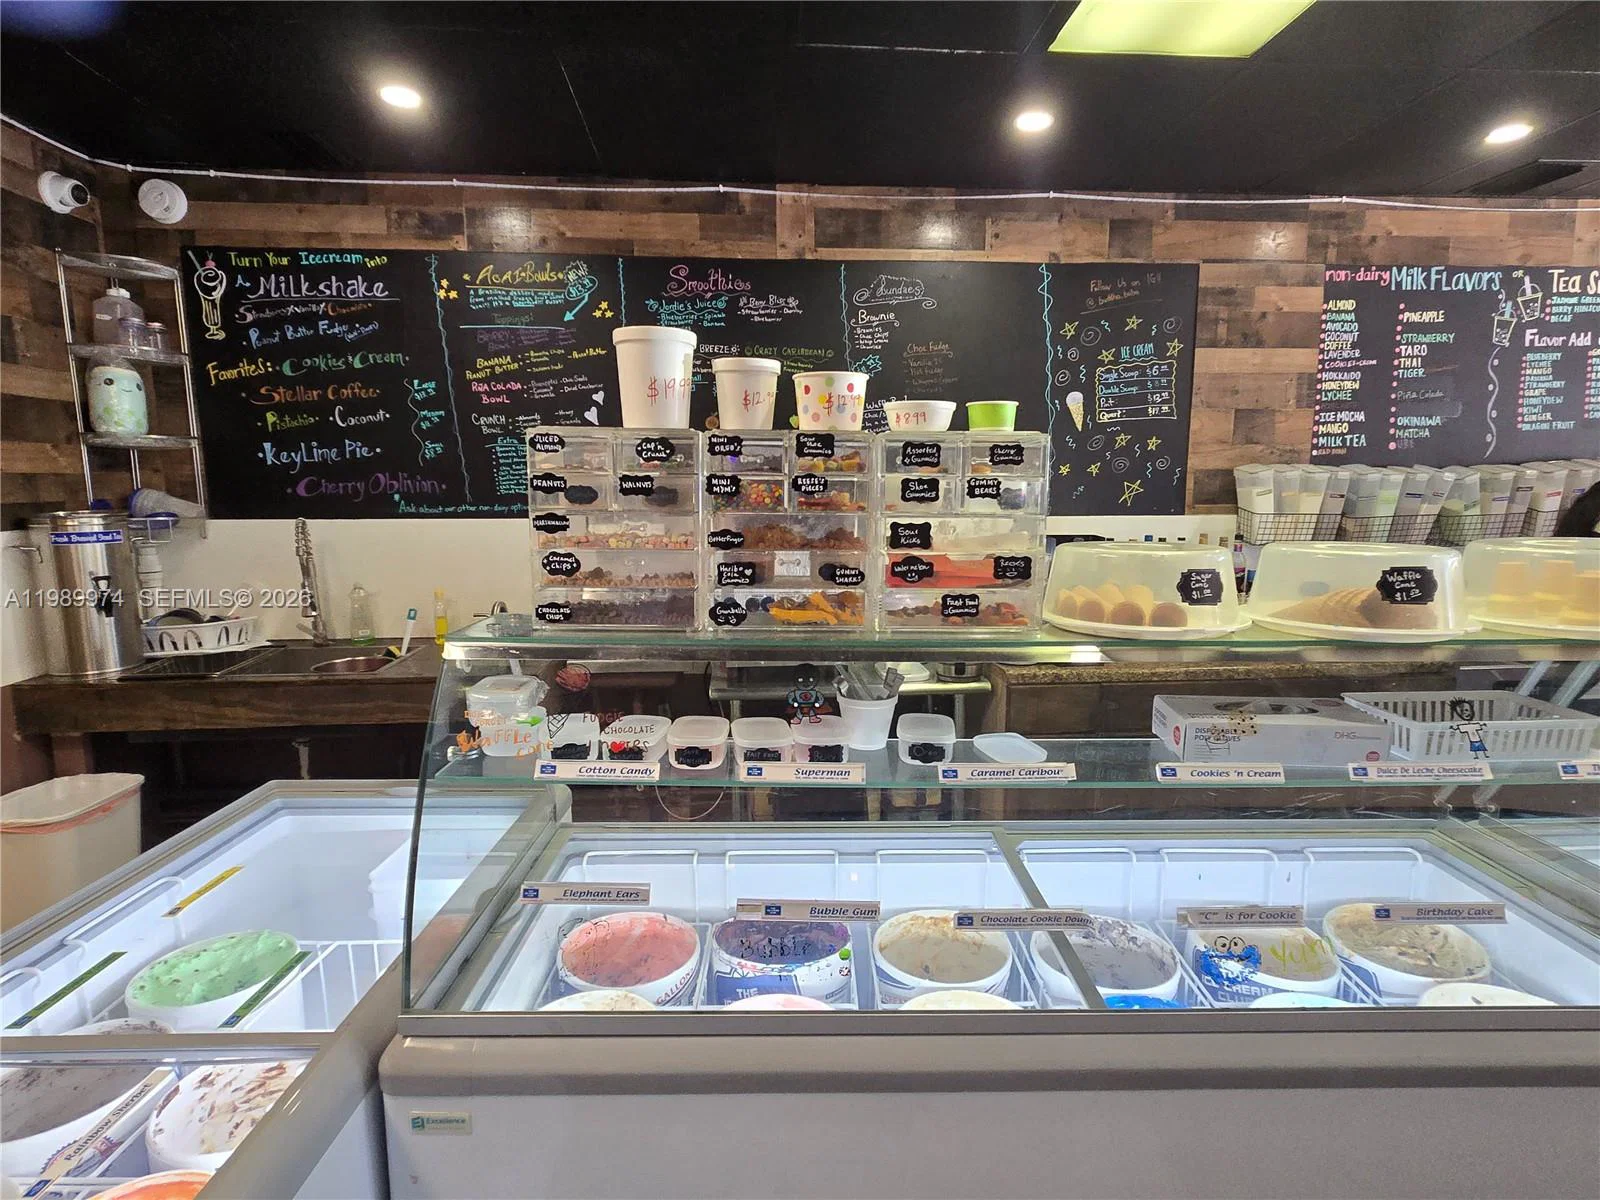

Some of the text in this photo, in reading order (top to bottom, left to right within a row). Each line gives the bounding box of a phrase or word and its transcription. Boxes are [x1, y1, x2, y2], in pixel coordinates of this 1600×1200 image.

[229, 252, 263, 267] Turn
[265, 252, 291, 267] Your
[667, 265, 751, 293] Smoothies
[1325, 266, 1390, 286] non-dairy
[1391, 266, 1428, 291] Milk
[695, 299, 717, 309] Juice
[1327, 300, 1356, 311] ALMOND
[858, 309, 896, 324] Brownie
[1403, 310, 1444, 322] PINEAPPLE
[1401, 333, 1455, 344] STRAWBERRY
[1568, 331, 1592, 346] Add
[700, 344, 730, 353] BREEZE
[754, 345, 778, 355] CRAZY
[1121, 343, 1154, 359] ICE CREAM
[1400, 345, 1428, 356] TARO
[282, 355, 345, 375] Cookies
[353, 352, 405, 369] Cream
[1400, 357, 1422, 368] THAI
[1322, 371, 1361, 380] HOKKAIDO
[1398, 368, 1425, 378] TIGER
[251, 383, 378, 404] Stellar Coffee
[1321, 391, 1352, 401] LYCHEE
[266, 411, 315, 432] Pistachio
[471, 413, 506, 425] CRUNCH
[1336, 411, 1366, 422] MOCHA
[1397, 416, 1442, 426] OKINAWA
[1318, 423, 1349, 434] MANGO
[1396, 429, 1430, 438] MATCHA
[534, 435, 559, 443] SLICED
[1318, 434, 1366, 448] MILK TEA
[345, 439, 374, 457] Pie
[296, 472, 438, 501] Cherry Oblivion
[532, 479, 565, 488] PEANUTS
[621, 480, 652, 489] WALNUTS
[974, 487, 997, 495] BEARS
[551, 562, 572, 571] Chips
[603, 724, 655, 735] CHOCOLATE
[579, 766, 655, 776] Cotton Candy
[794, 767, 851, 779] Superman
[970, 768, 1015, 777] Caramel
[1190, 769, 1230, 778] Cookies
[1246, 770, 1281, 778] Cream
[562, 889, 640, 900] Elephant Ears
[809, 906, 877, 916] Bubble Gum
[1225, 911, 1234, 920] is
[1237, 911, 1255, 920] for
[1258, 911, 1296, 920] Cookie
[1416, 907, 1494, 917] Birthday Cake
[980, 915, 1028, 923] Chocolate
[1030, 915, 1061, 923] Cookie
[64, 1118, 112, 1161] Rainbow
[111, 1083, 153, 1117] Sherbet
